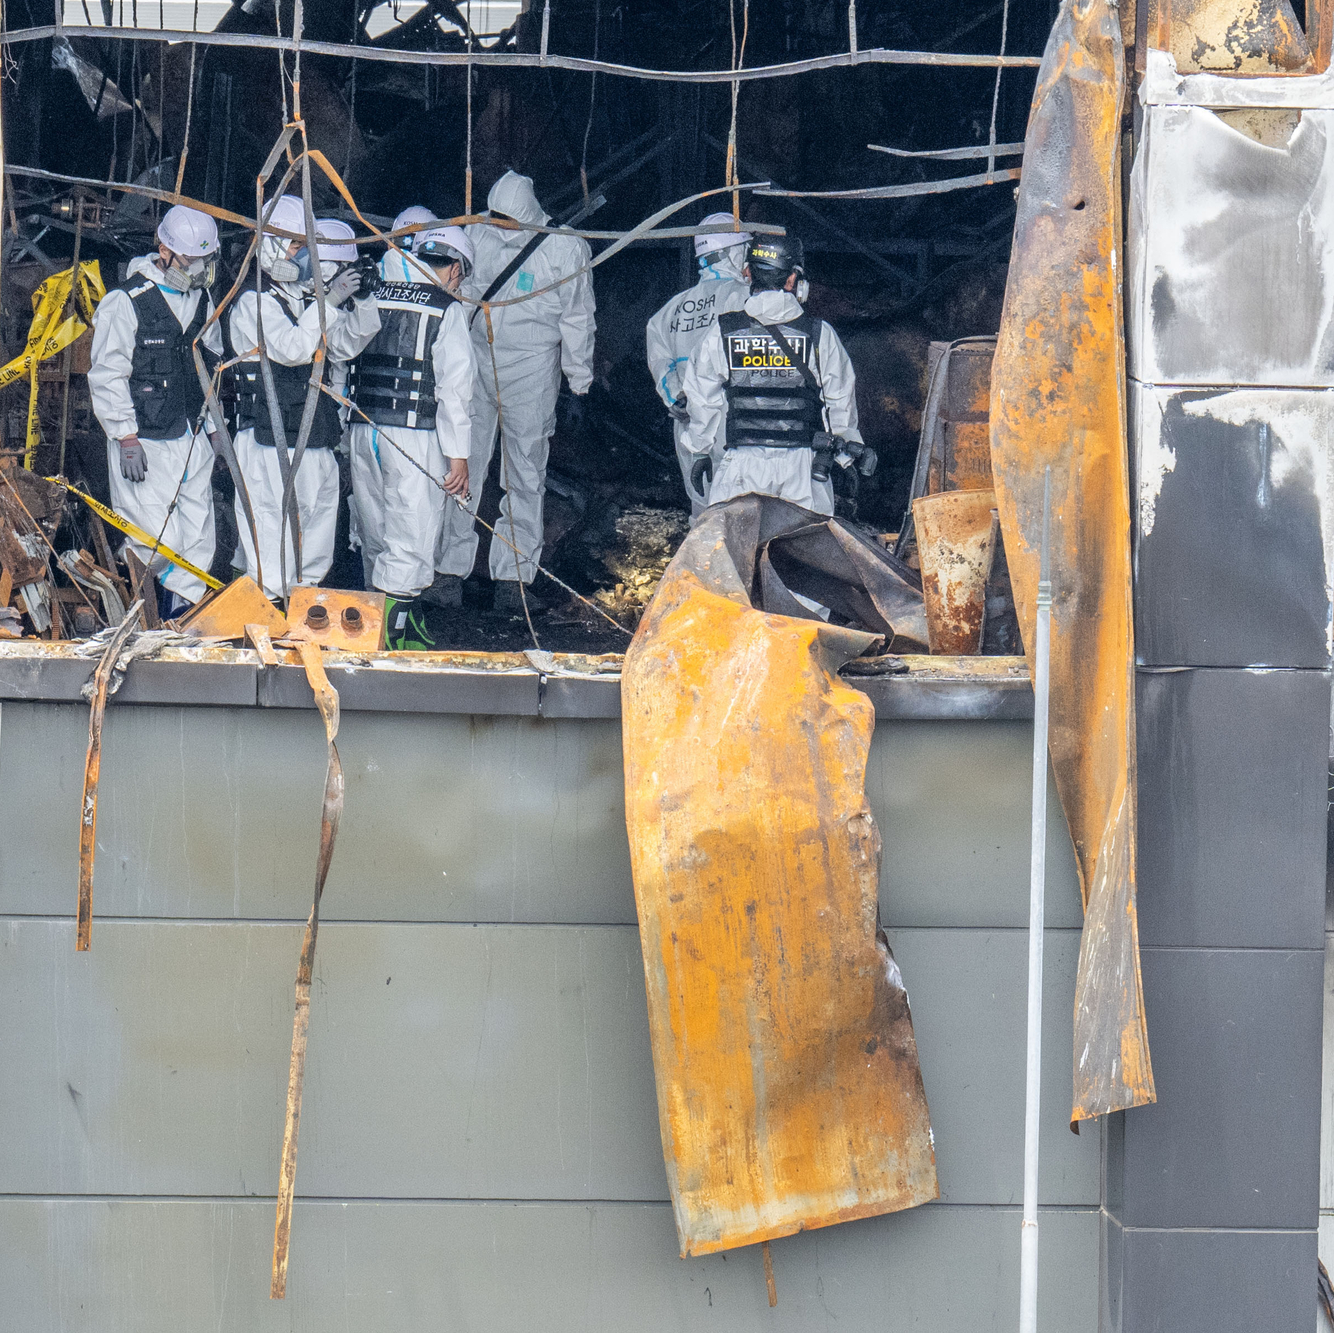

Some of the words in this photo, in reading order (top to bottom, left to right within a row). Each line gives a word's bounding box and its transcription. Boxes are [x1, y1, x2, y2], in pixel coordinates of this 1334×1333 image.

[752, 249, 777, 260] 과학수사
[374, 287, 432, 305] 앙사고조사단
[674, 294, 716, 316] KOSHA
[743, 355, 792, 367] POLICE
